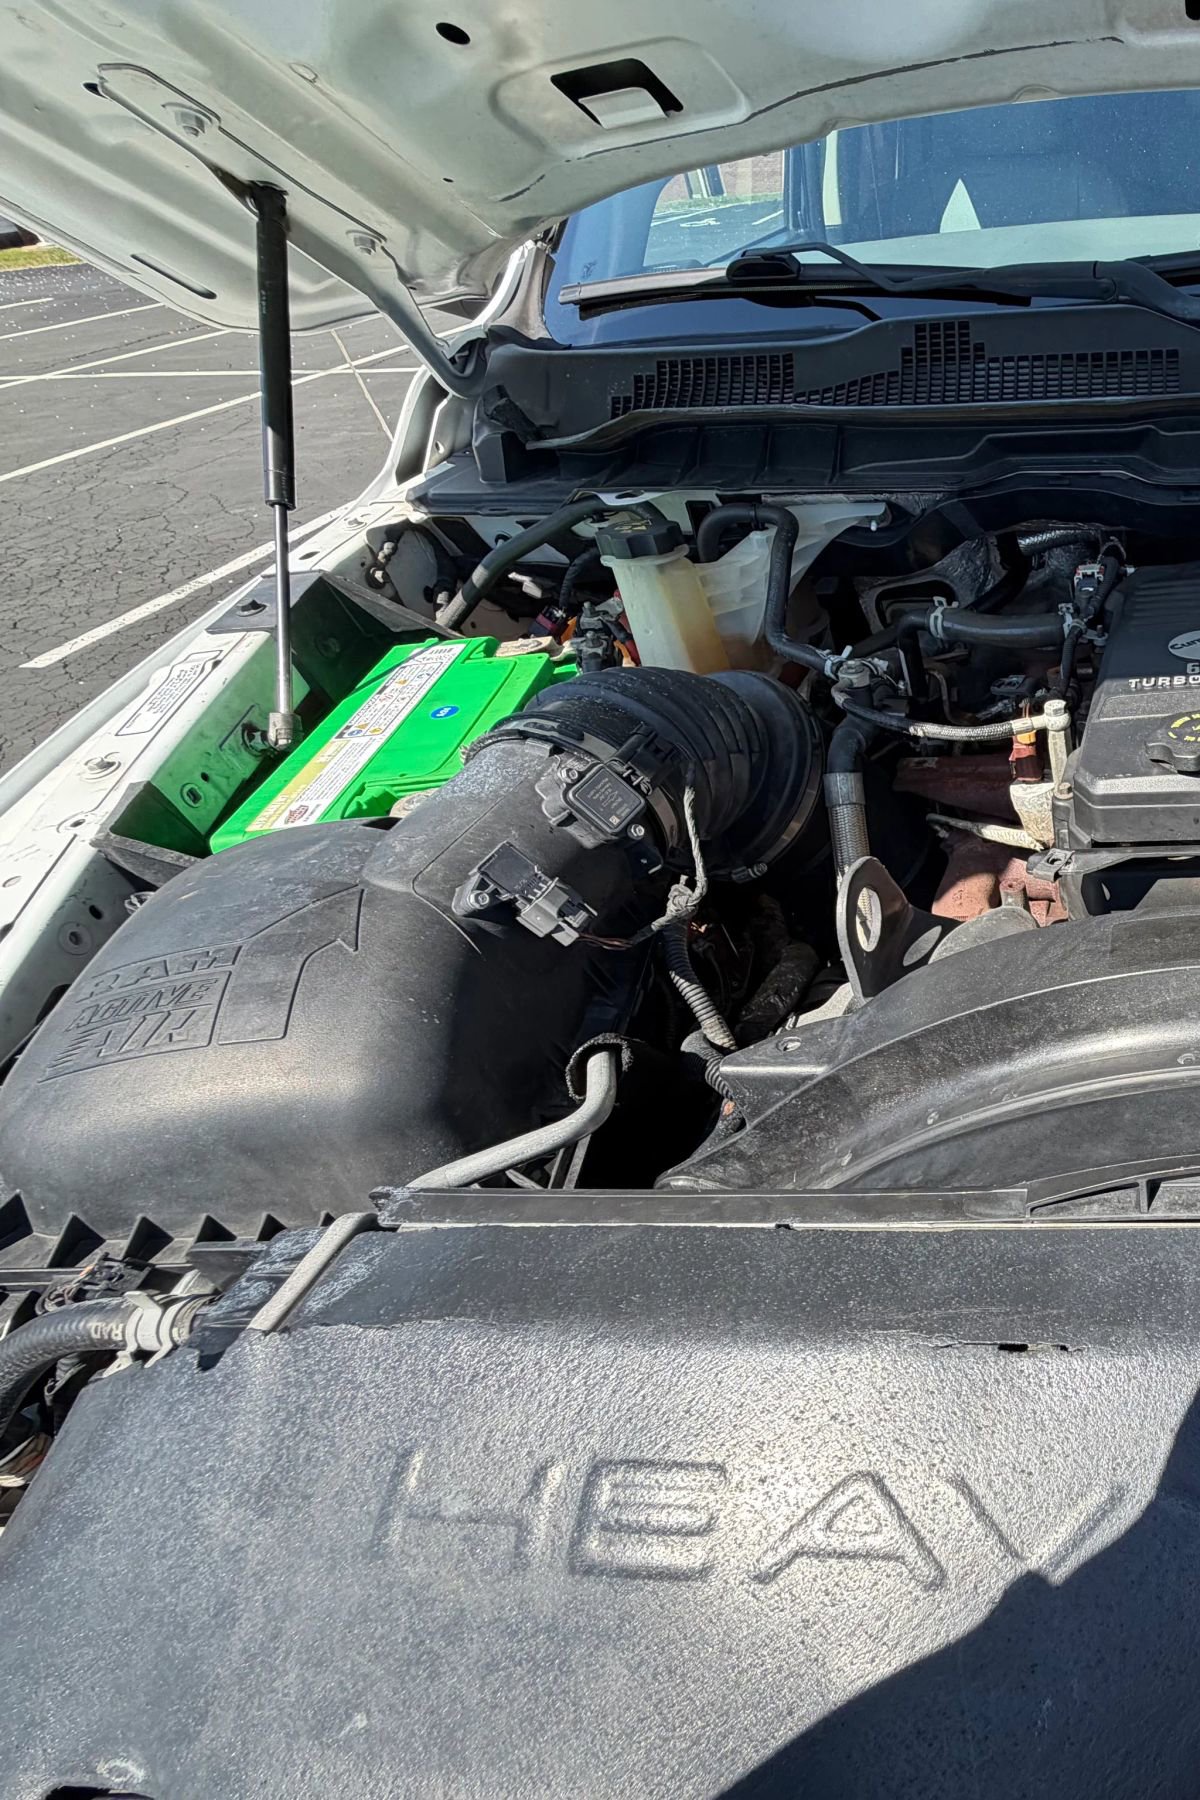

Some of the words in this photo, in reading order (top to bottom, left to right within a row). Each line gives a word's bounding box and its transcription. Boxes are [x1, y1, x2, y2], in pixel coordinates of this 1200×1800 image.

[75, 945, 243, 1003] RAM
[65, 977, 220, 1032] ACTIVE
[76, 1008, 202, 1058] AIR
